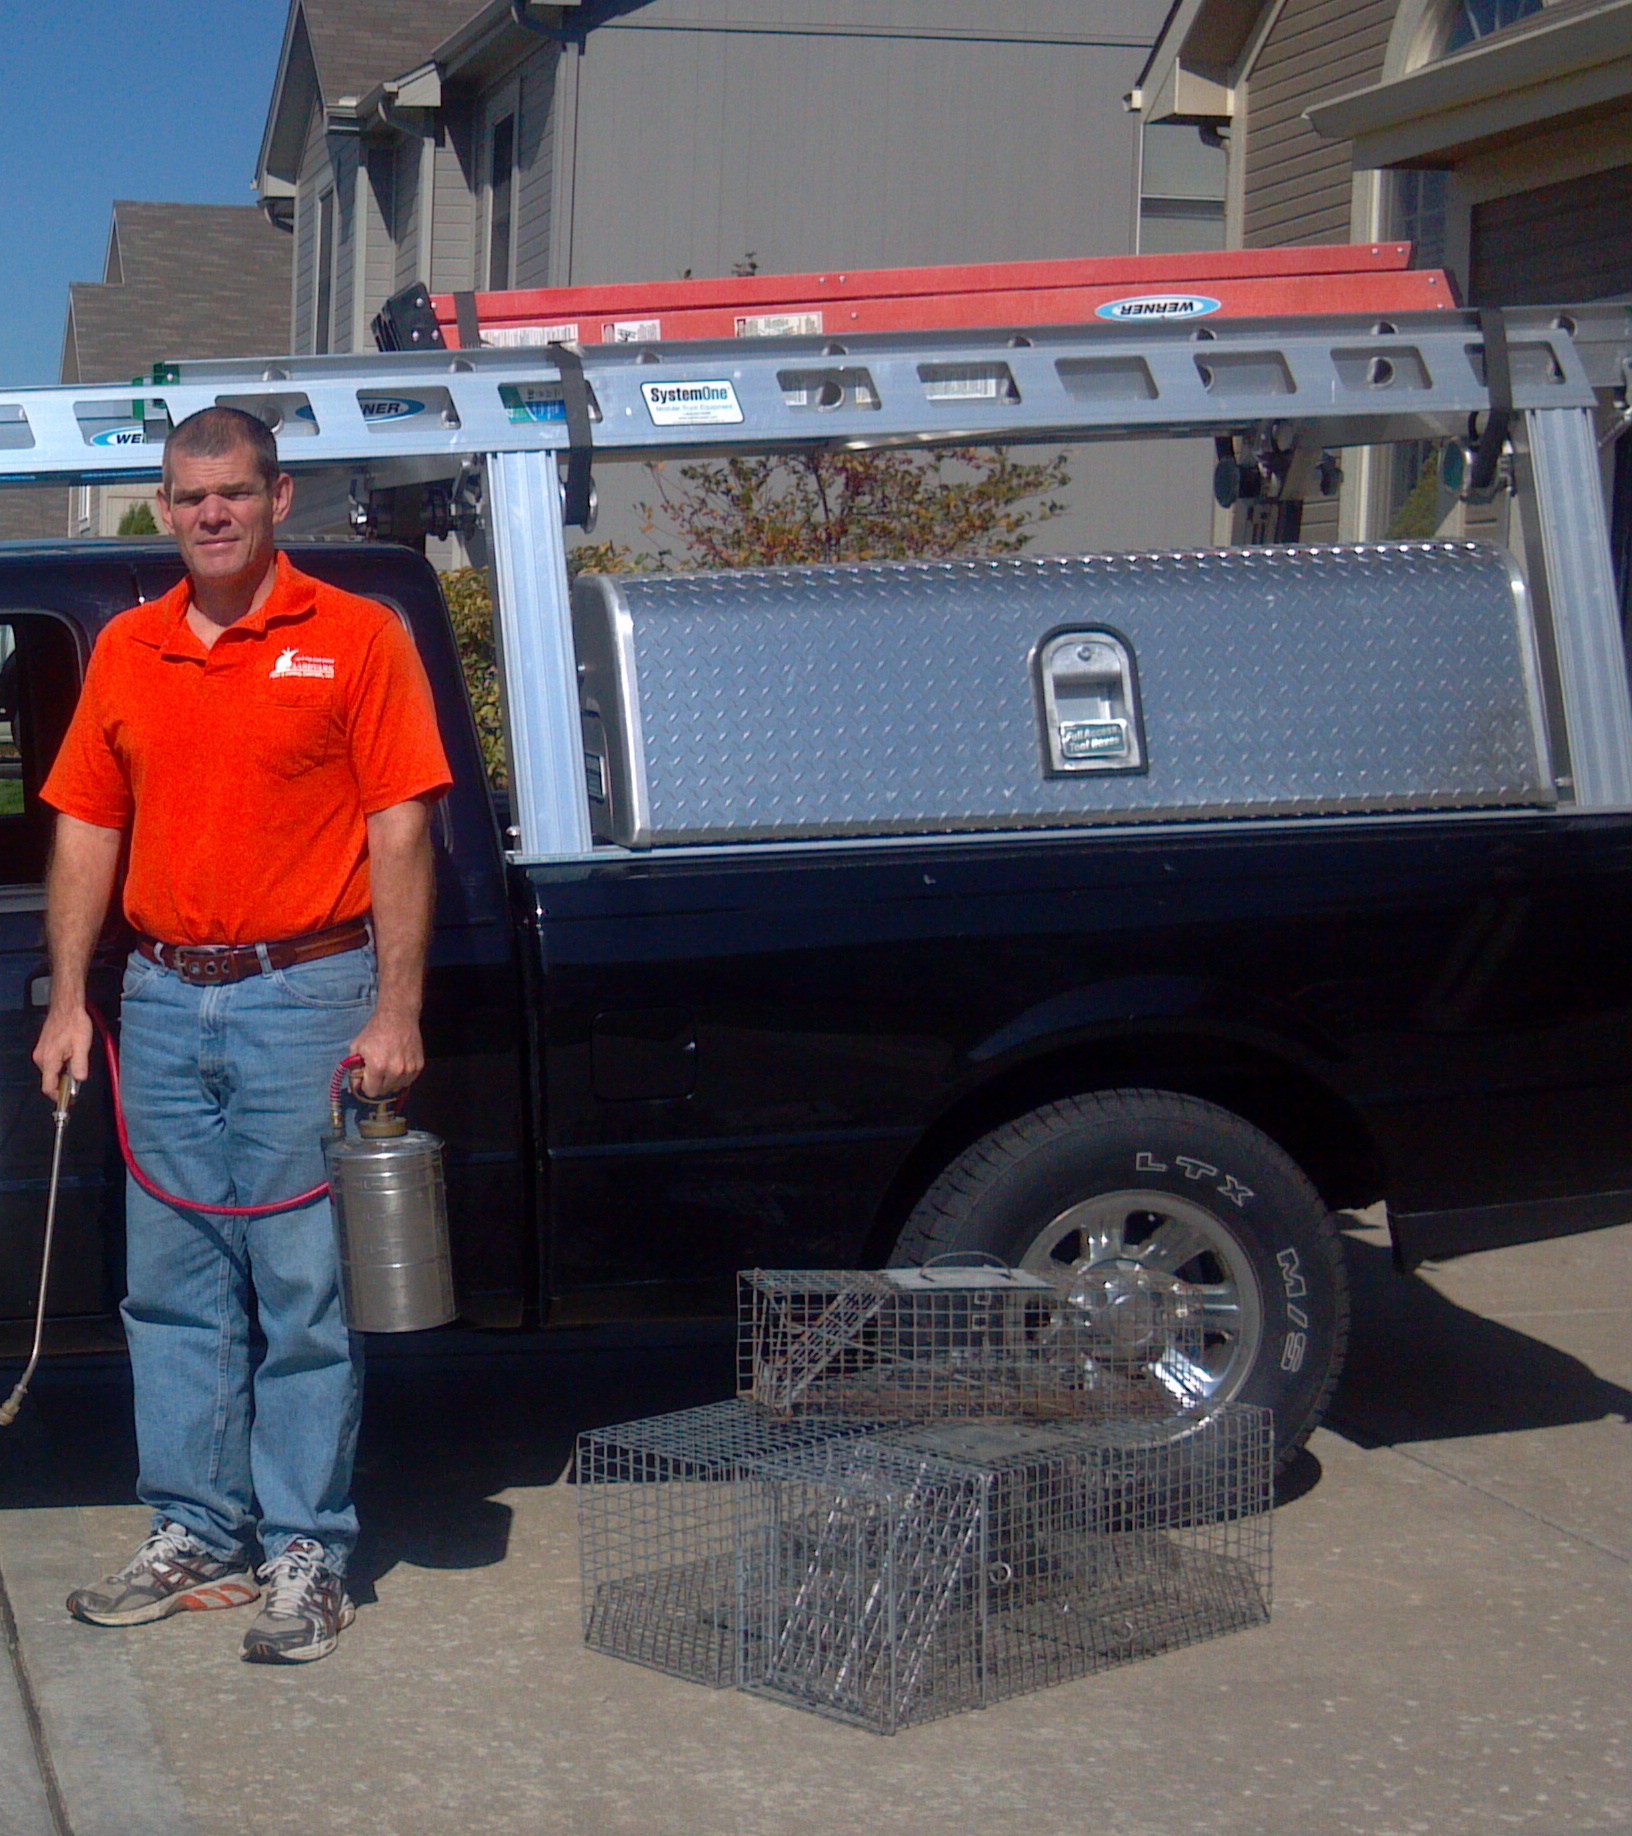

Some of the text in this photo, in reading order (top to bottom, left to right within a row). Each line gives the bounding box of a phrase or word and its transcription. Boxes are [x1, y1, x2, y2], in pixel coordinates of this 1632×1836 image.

[1120, 301, 1194, 315] WERNER
[650, 386, 728, 404] SystemOne
[1136, 1152, 1308, 1372] LTX M/S
